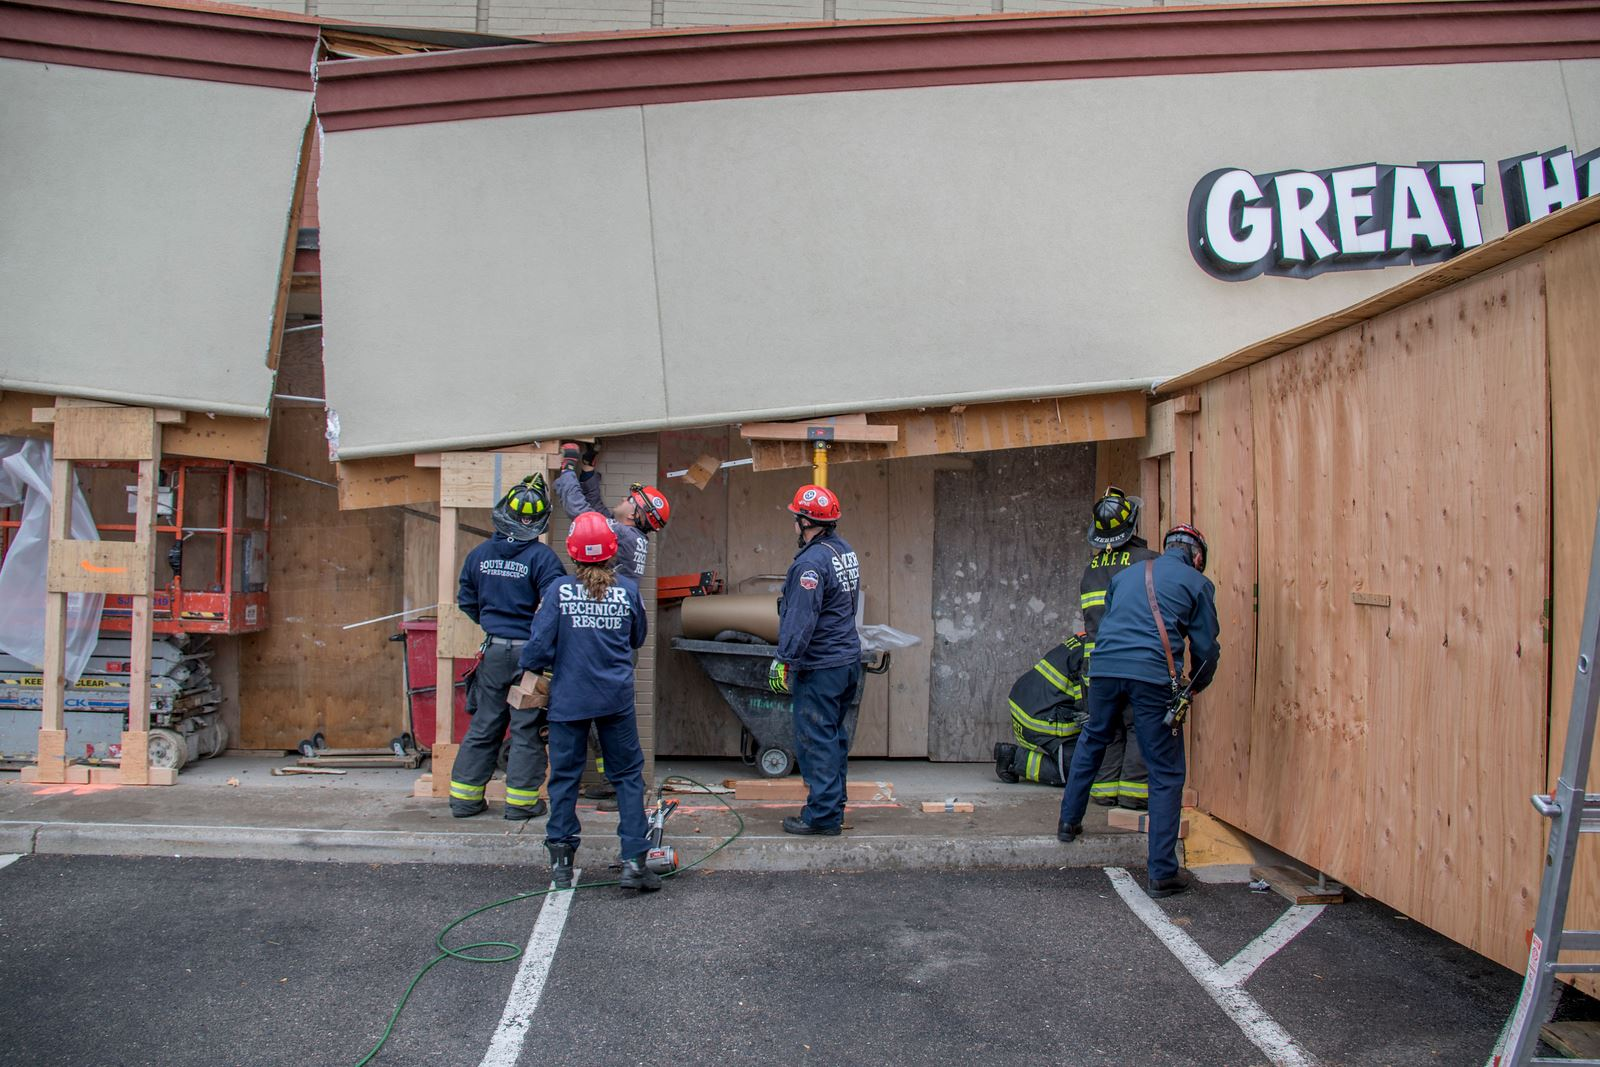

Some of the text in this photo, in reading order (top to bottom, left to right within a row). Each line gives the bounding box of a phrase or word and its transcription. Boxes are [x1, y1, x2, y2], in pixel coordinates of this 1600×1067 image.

[1205, 161, 1485, 265] GREAT
[480, 559, 529, 575] SOUTH METRO
[560, 602, 630, 617] TECHNICAL
[571, 615, 622, 630] RESCUE
[24, 677, 104, 688] KEE CLEAR
